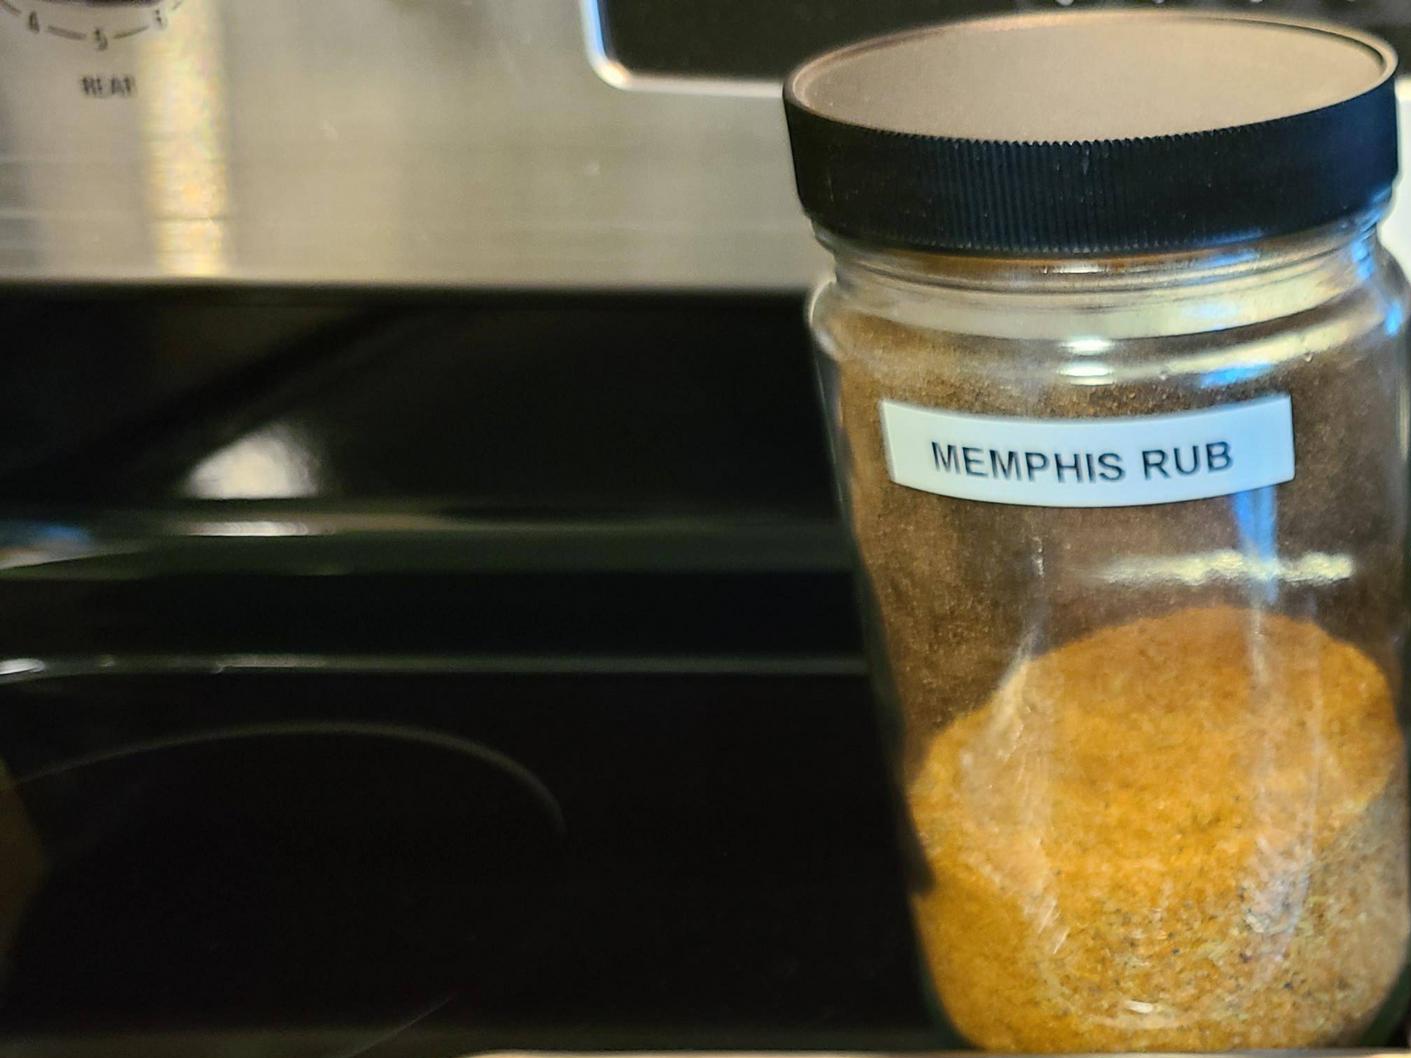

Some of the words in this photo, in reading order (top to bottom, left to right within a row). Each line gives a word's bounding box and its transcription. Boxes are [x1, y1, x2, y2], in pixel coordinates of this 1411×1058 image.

[81, 74, 136, 98] REAR
[930, 440, 1124, 484] MEMPHIS
[1142, 440, 1234, 482] RUB
